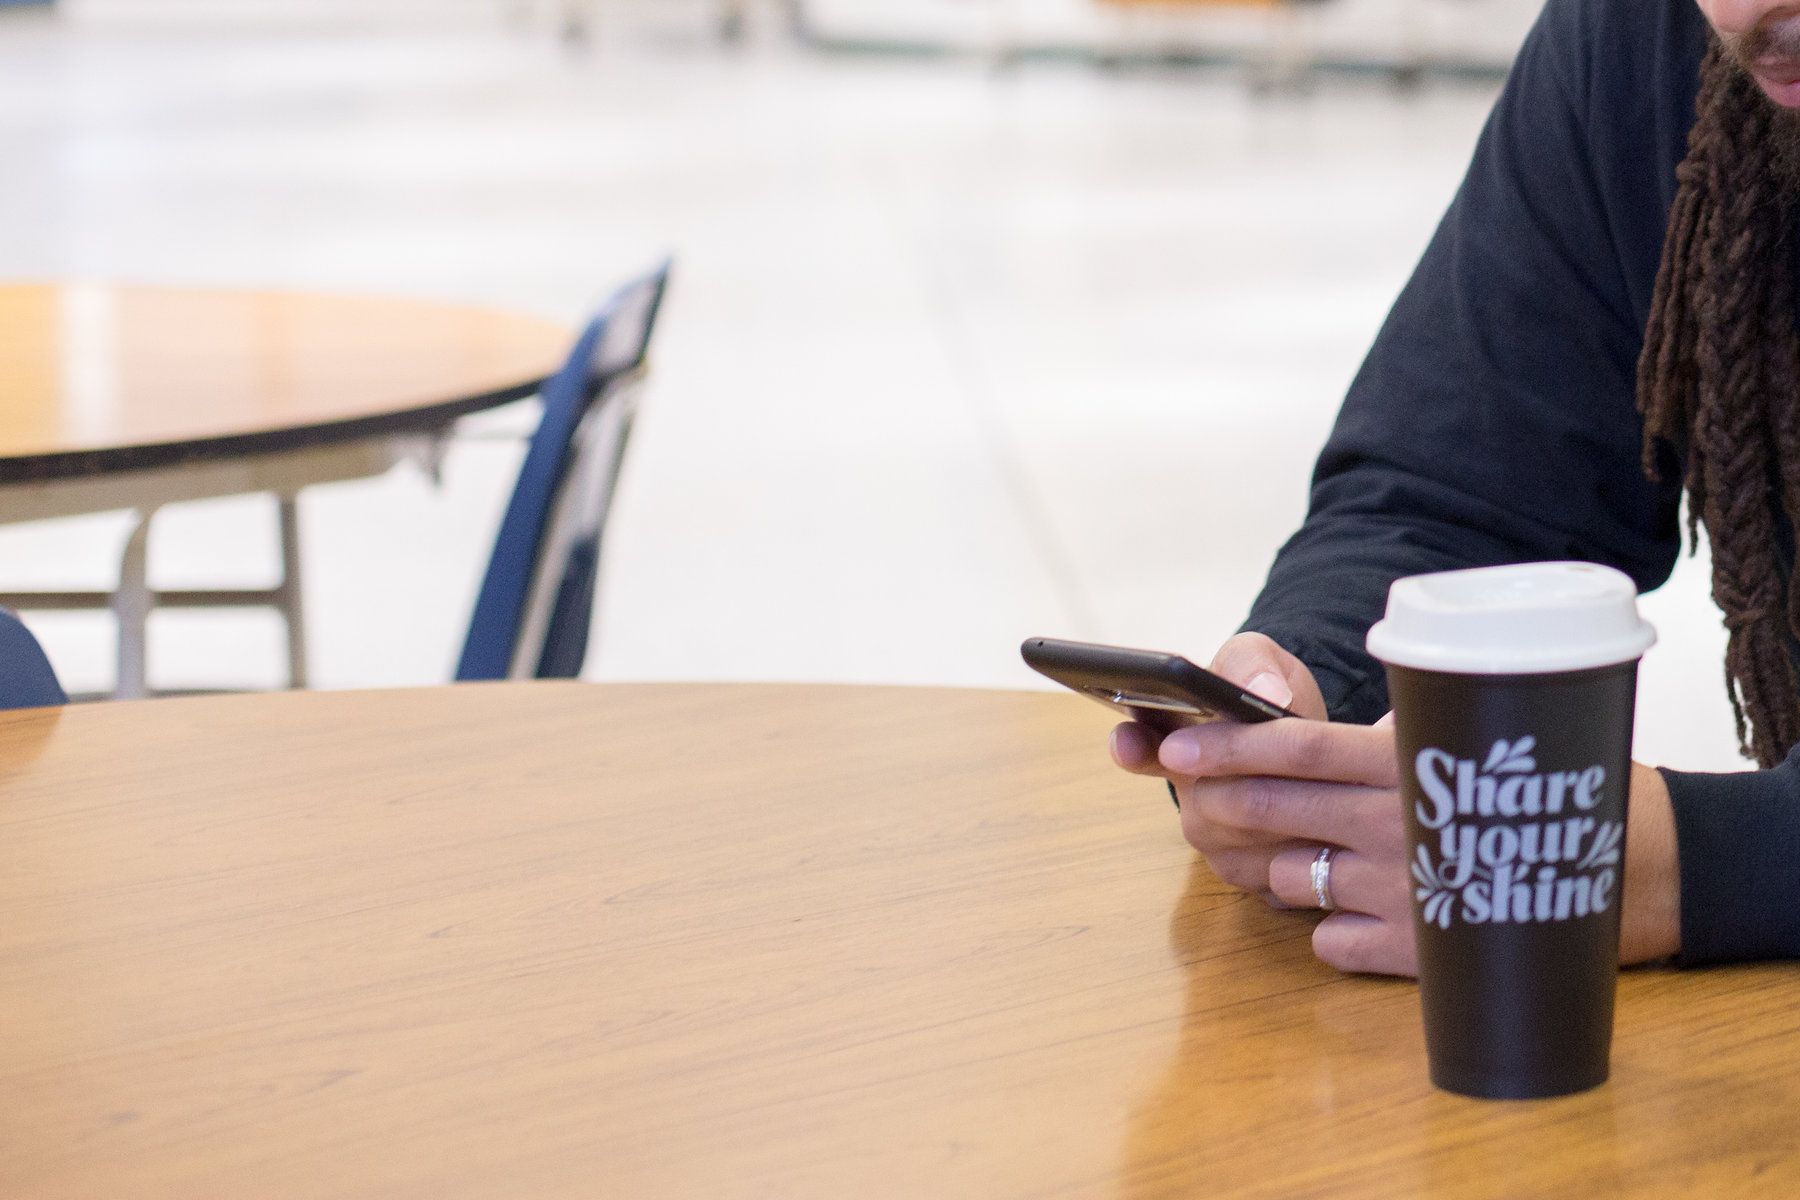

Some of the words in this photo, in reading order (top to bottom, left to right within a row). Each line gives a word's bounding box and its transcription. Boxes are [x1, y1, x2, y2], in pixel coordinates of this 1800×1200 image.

[1414, 747, 1606, 829] Share
[1438, 816, 1596, 889] your
[1461, 862, 1617, 924] shine
